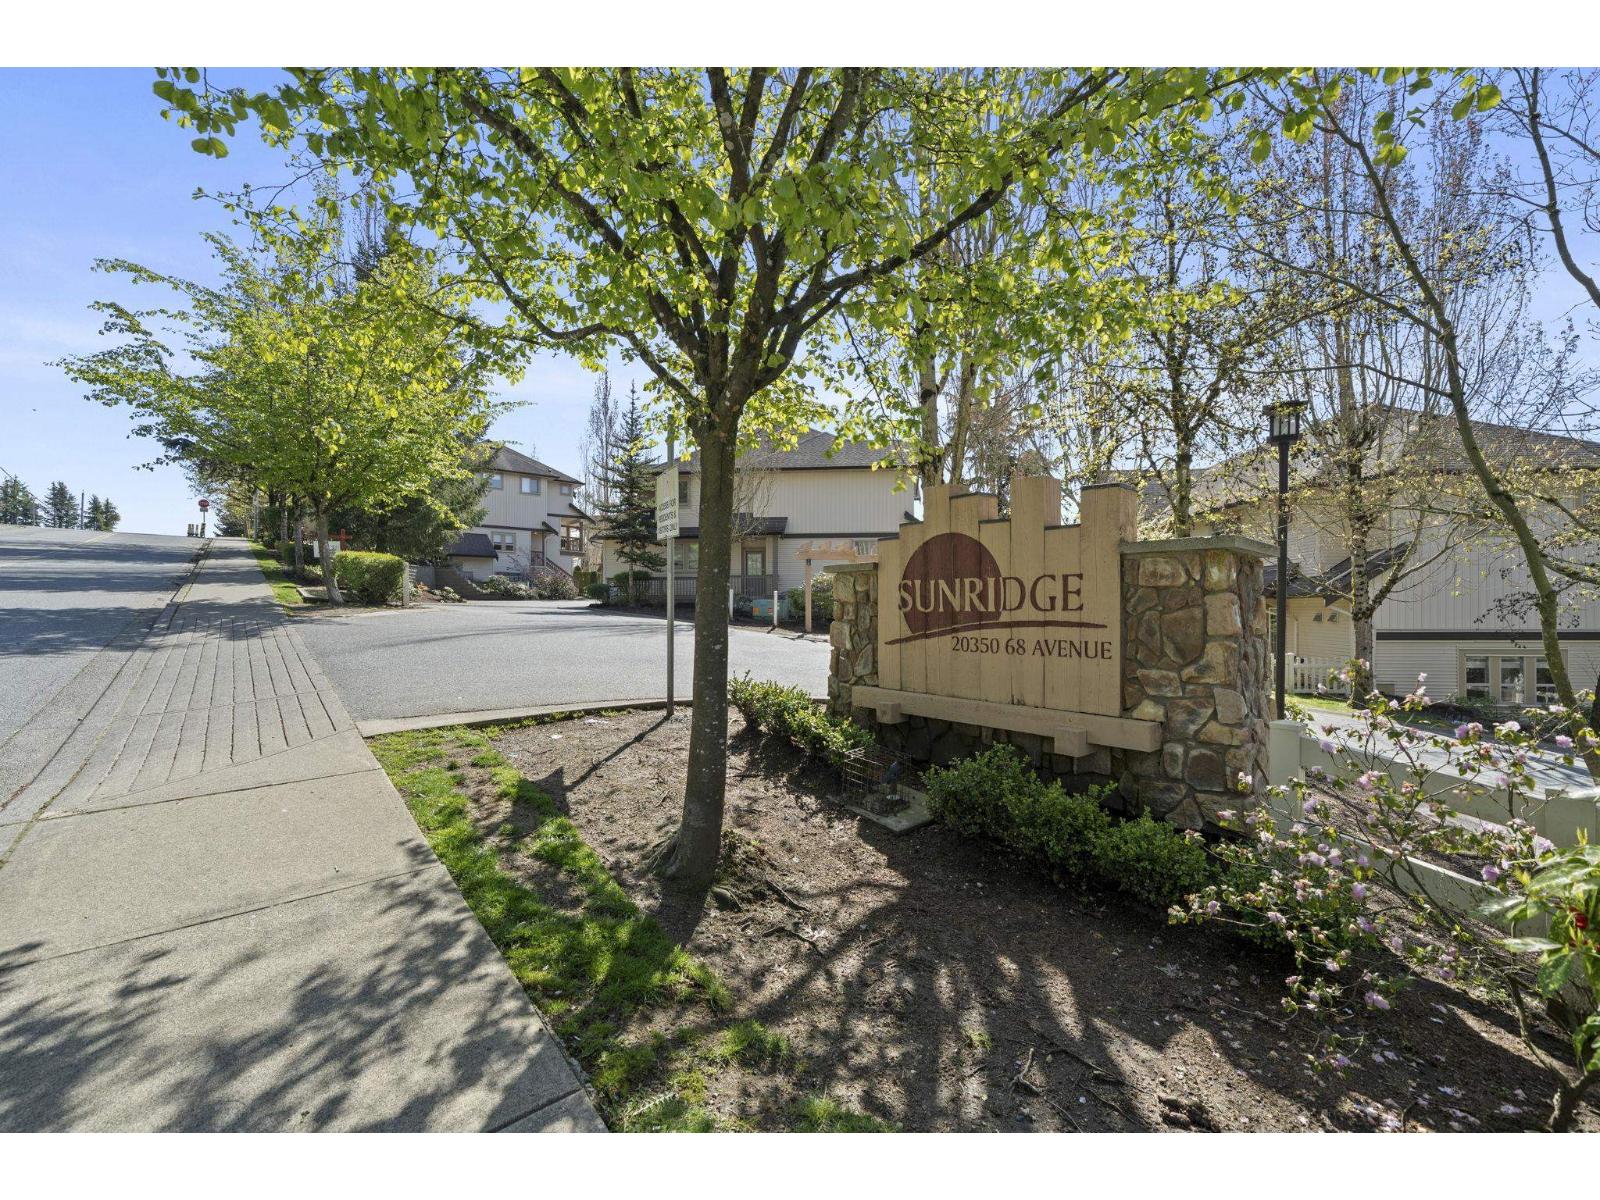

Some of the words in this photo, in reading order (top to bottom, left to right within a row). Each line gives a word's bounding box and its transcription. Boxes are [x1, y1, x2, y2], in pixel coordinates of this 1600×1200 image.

[898, 573, 1084, 613] SUNRIDGE
[951, 636, 999, 655] 20350
[1005, 637, 1026, 656] 68
[1032, 639, 1113, 660] AVENUE
